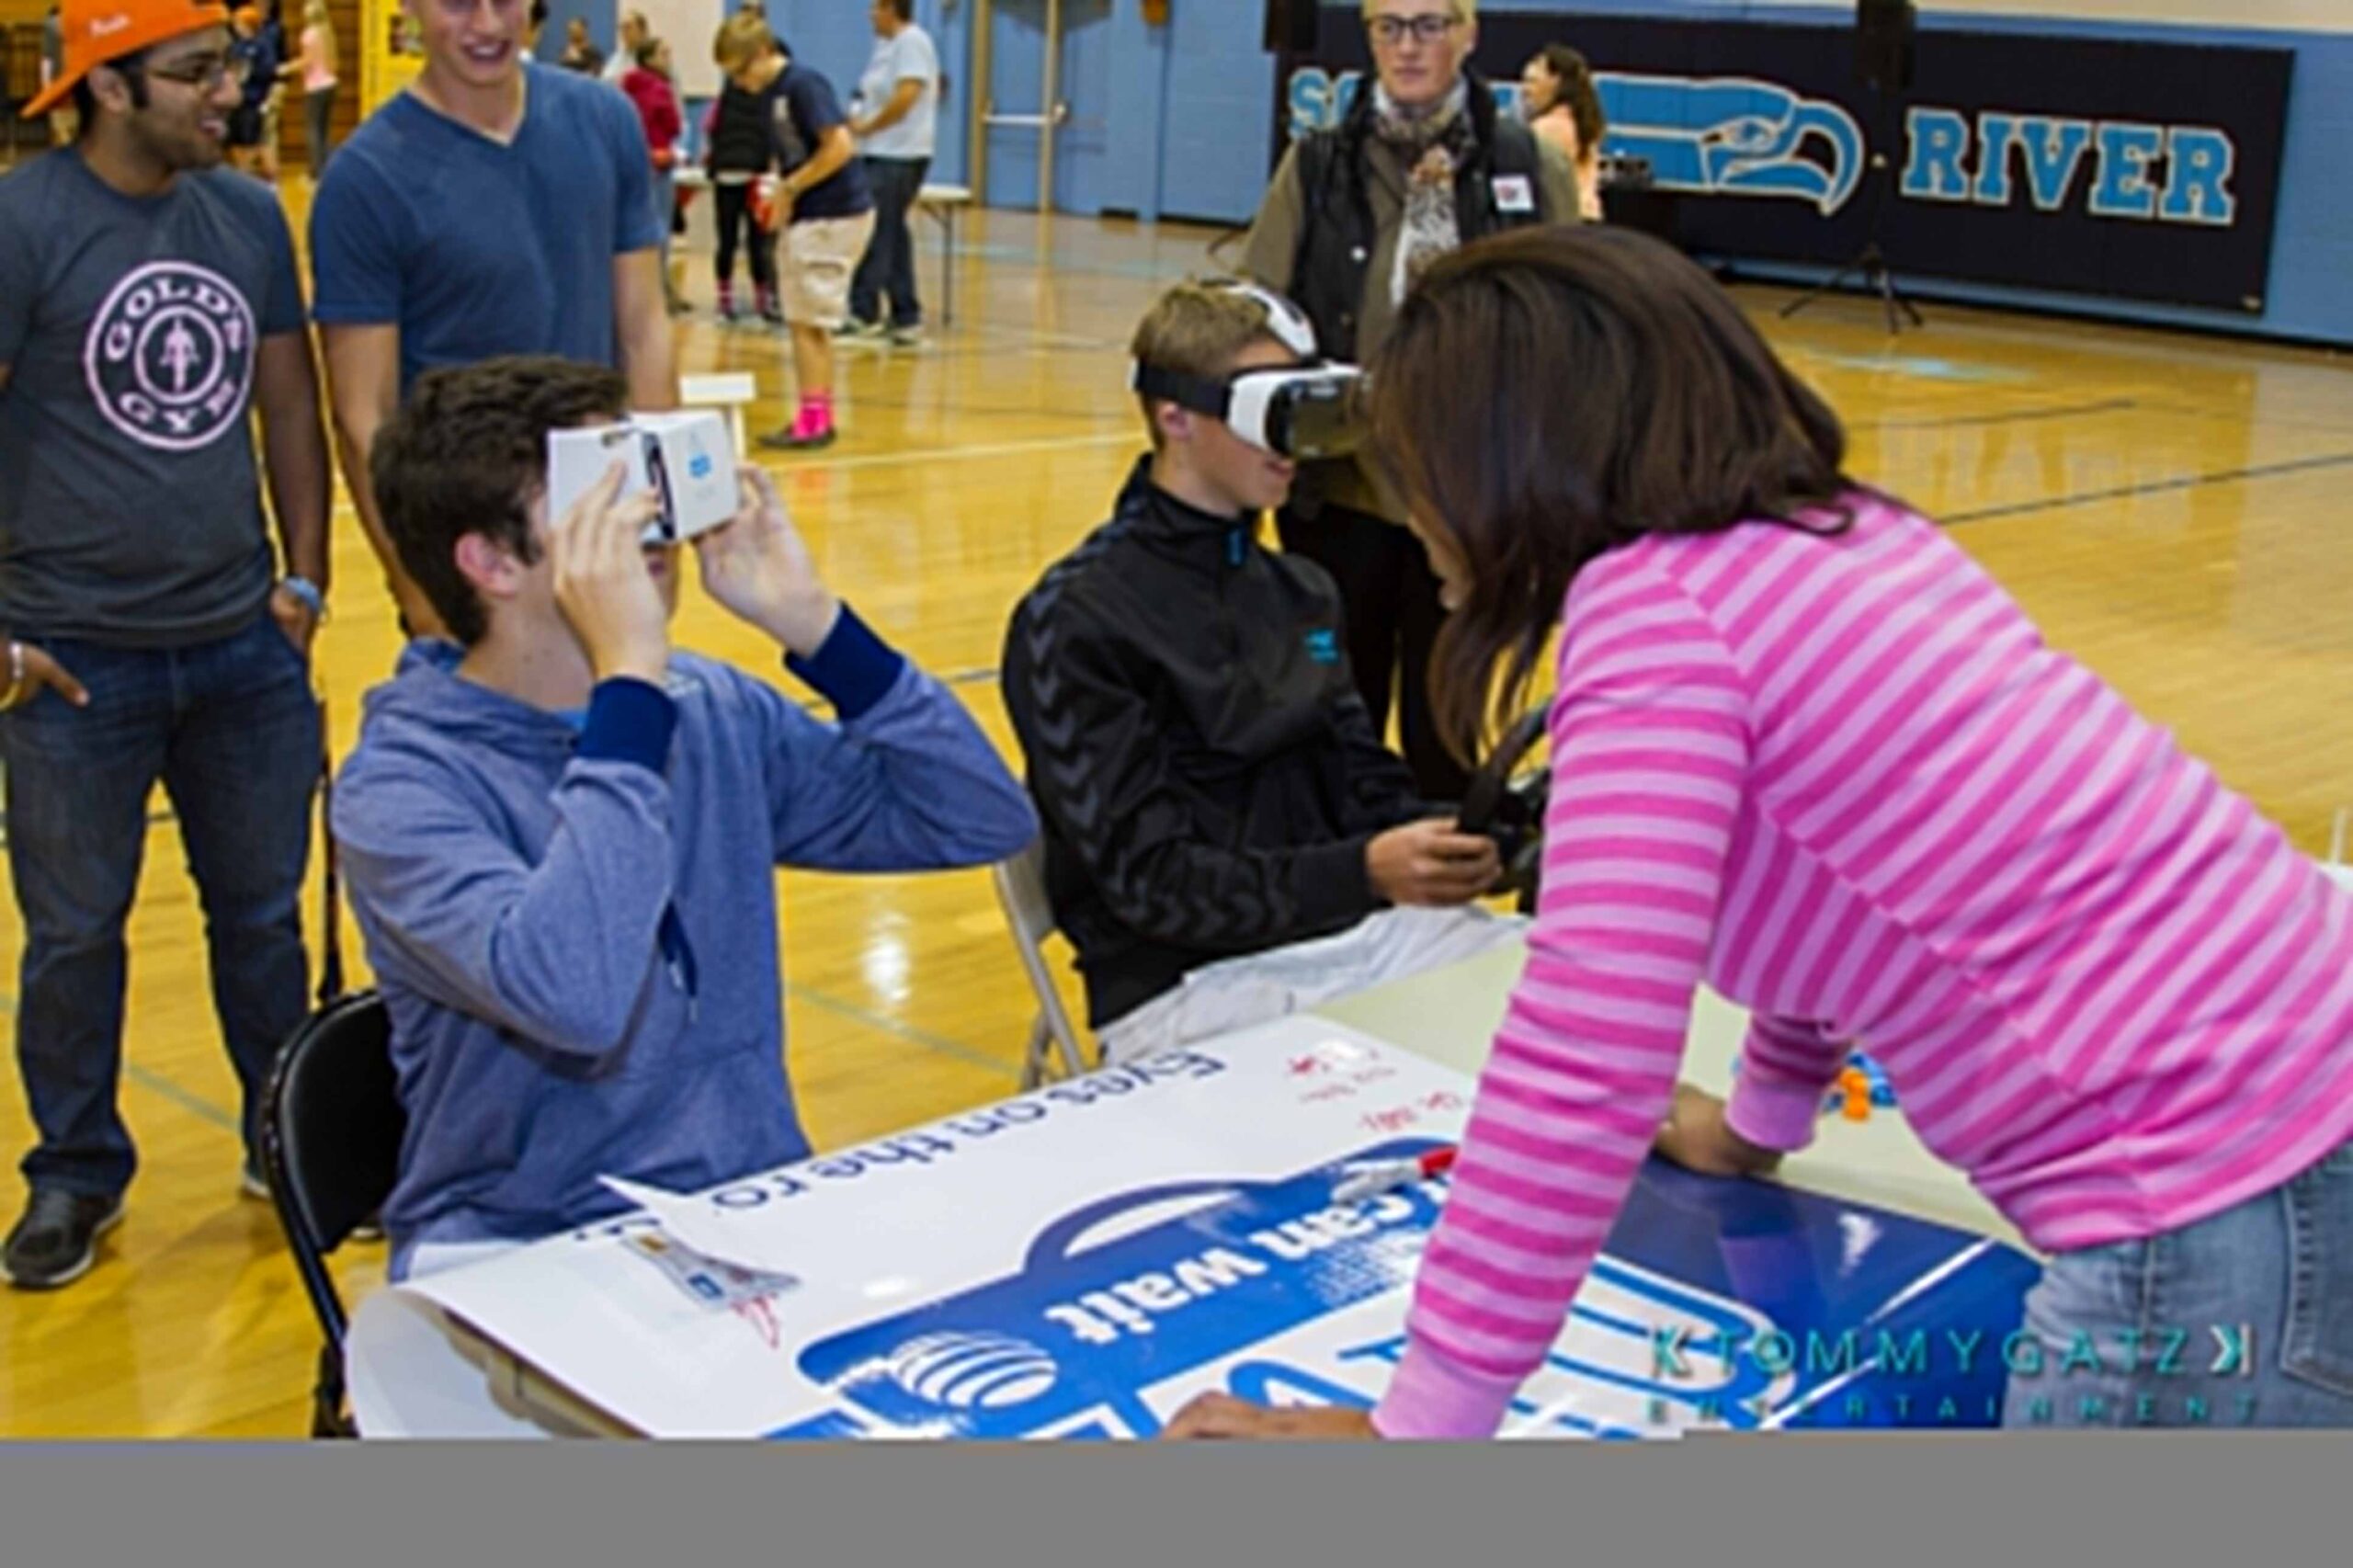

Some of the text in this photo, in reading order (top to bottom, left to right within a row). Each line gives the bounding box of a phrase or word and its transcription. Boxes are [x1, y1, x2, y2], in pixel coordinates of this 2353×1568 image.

[1899, 105, 2236, 227] RIVER
[1045, 1051, 1226, 1105] Eyes
[944, 1100, 1048, 1137] on
[808, 1132, 956, 1177] the
[1246, 1194, 1415, 1259] can
[1042, 1246, 1269, 1345] wait
